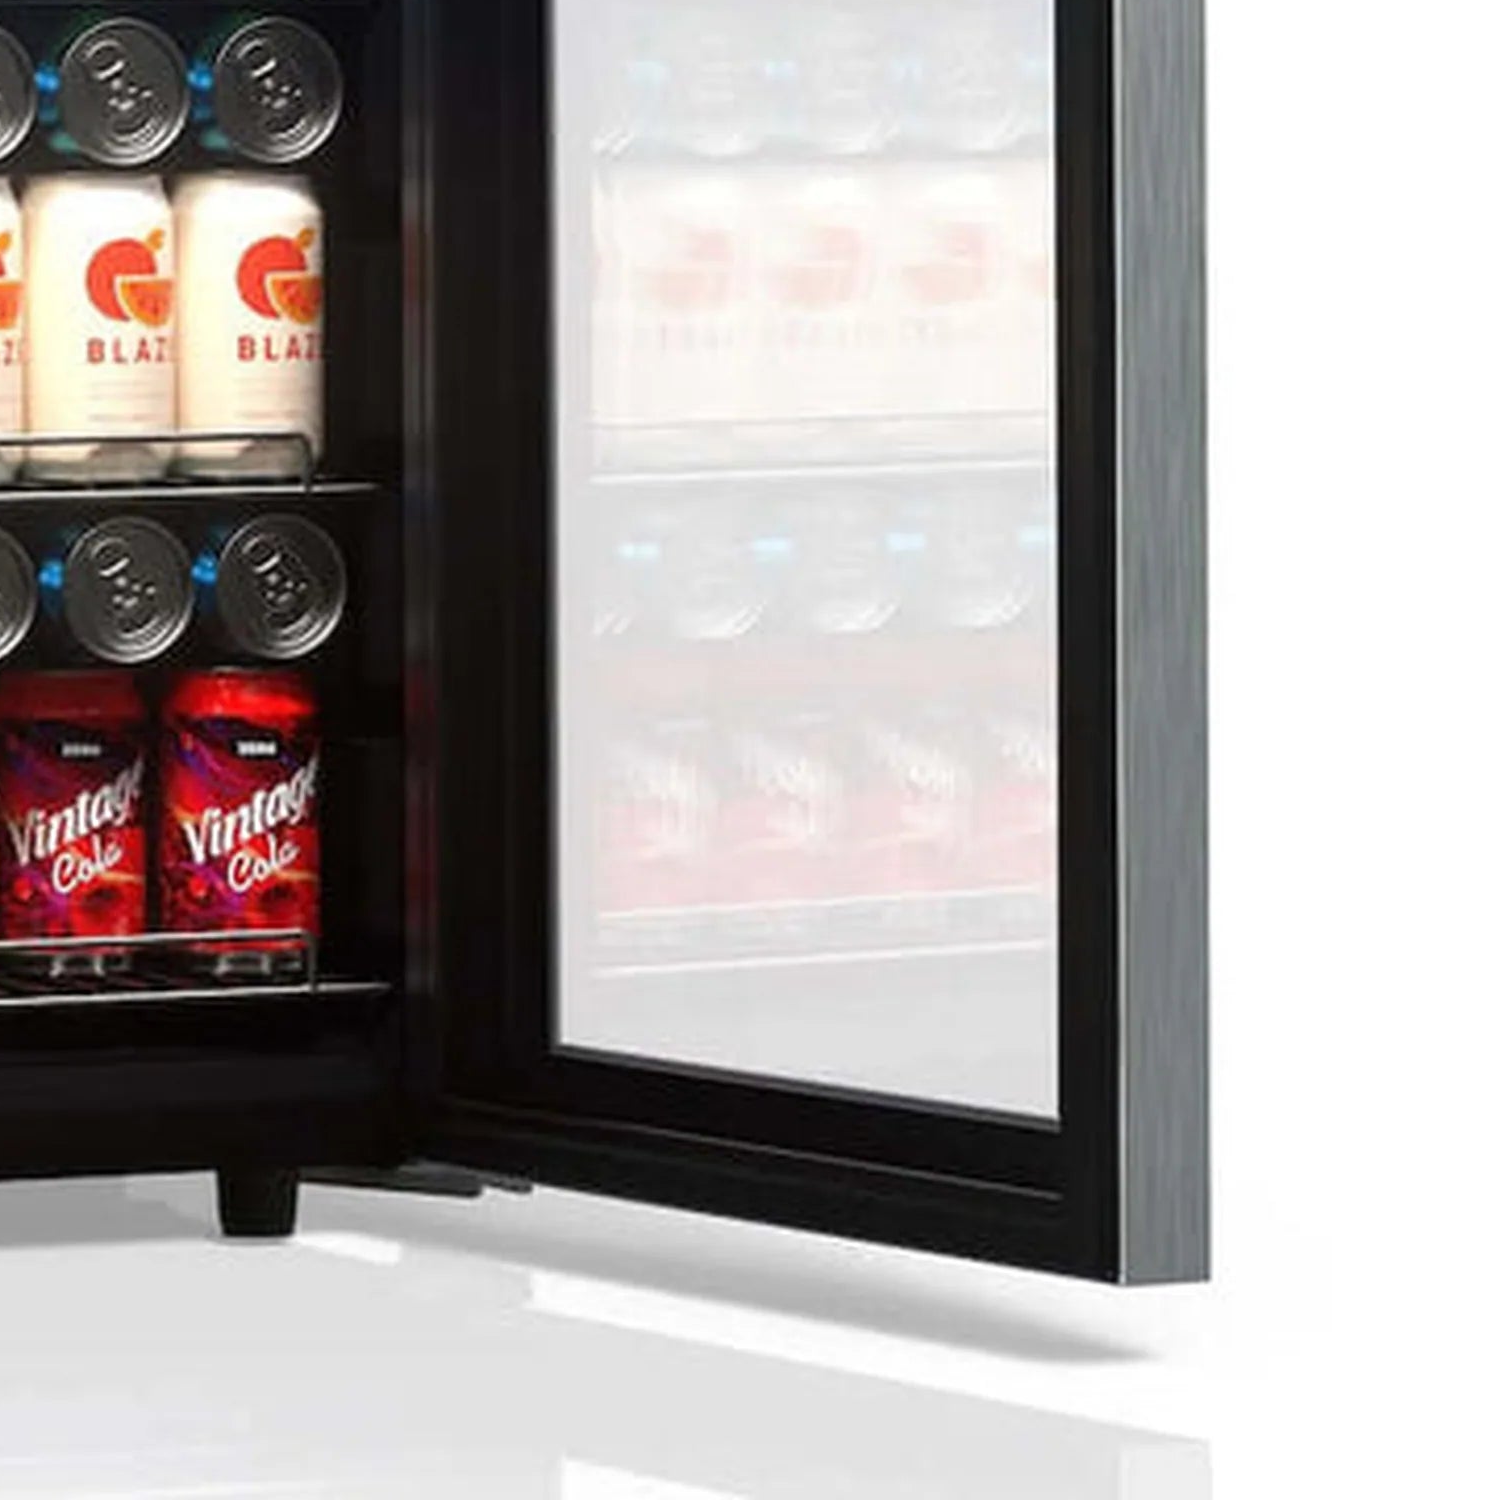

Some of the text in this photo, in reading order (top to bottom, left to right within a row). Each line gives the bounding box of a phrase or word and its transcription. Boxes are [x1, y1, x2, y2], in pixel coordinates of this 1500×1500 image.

[87, 336, 173, 365] BLAZ
[237, 334, 320, 363] BLAZ
[52, 833, 123, 894] Cola
[227, 833, 299, 893] Cola
